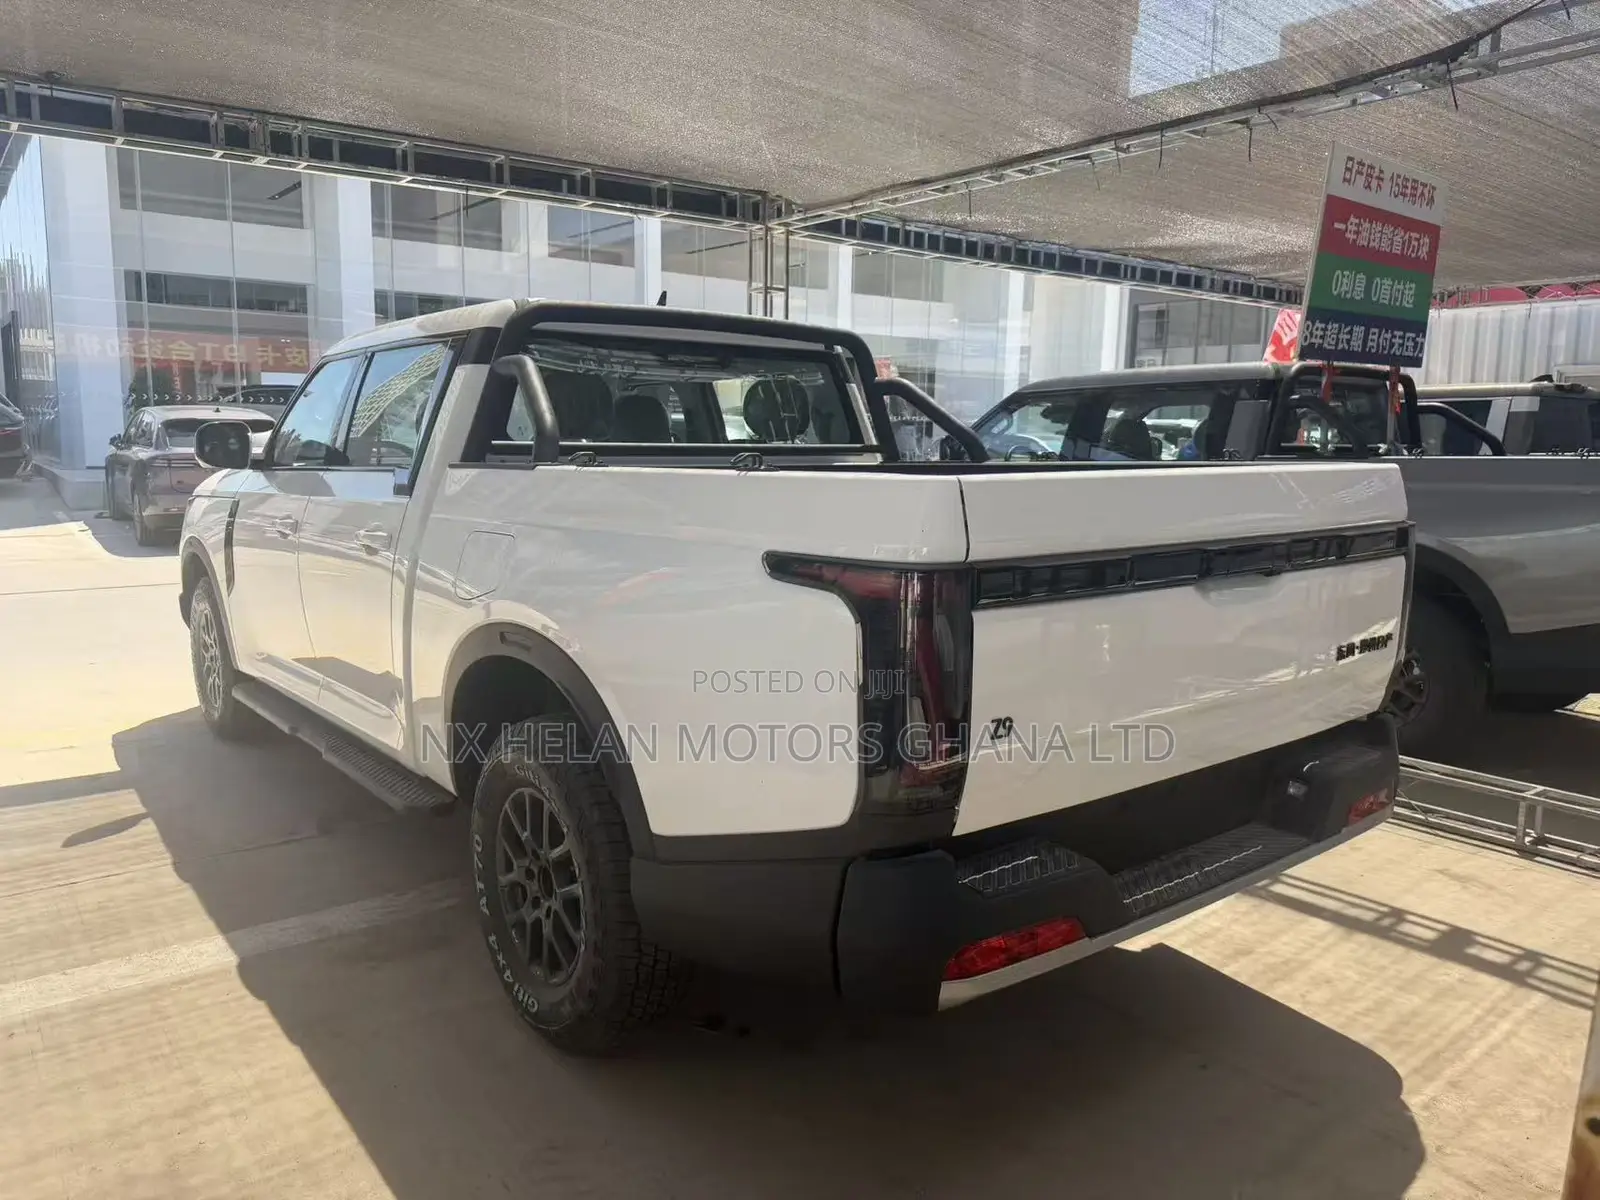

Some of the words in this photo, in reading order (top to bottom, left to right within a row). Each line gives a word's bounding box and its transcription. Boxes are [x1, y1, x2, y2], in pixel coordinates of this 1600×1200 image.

[1342, 156, 1385, 194] 日产皮卡
[1389, 172, 1437, 210] 15年用不坏
[1334, 214, 1430, 261] 一年油钱能省1万块
[1331, 269, 1367, 300] 0利息
[1371, 277, 1416, 308] 0首付起
[1302, 320, 1365, 353] 8年超长期
[1366, 327, 1426, 357] 月付无压力
[990, 716, 1014, 740] Z9
